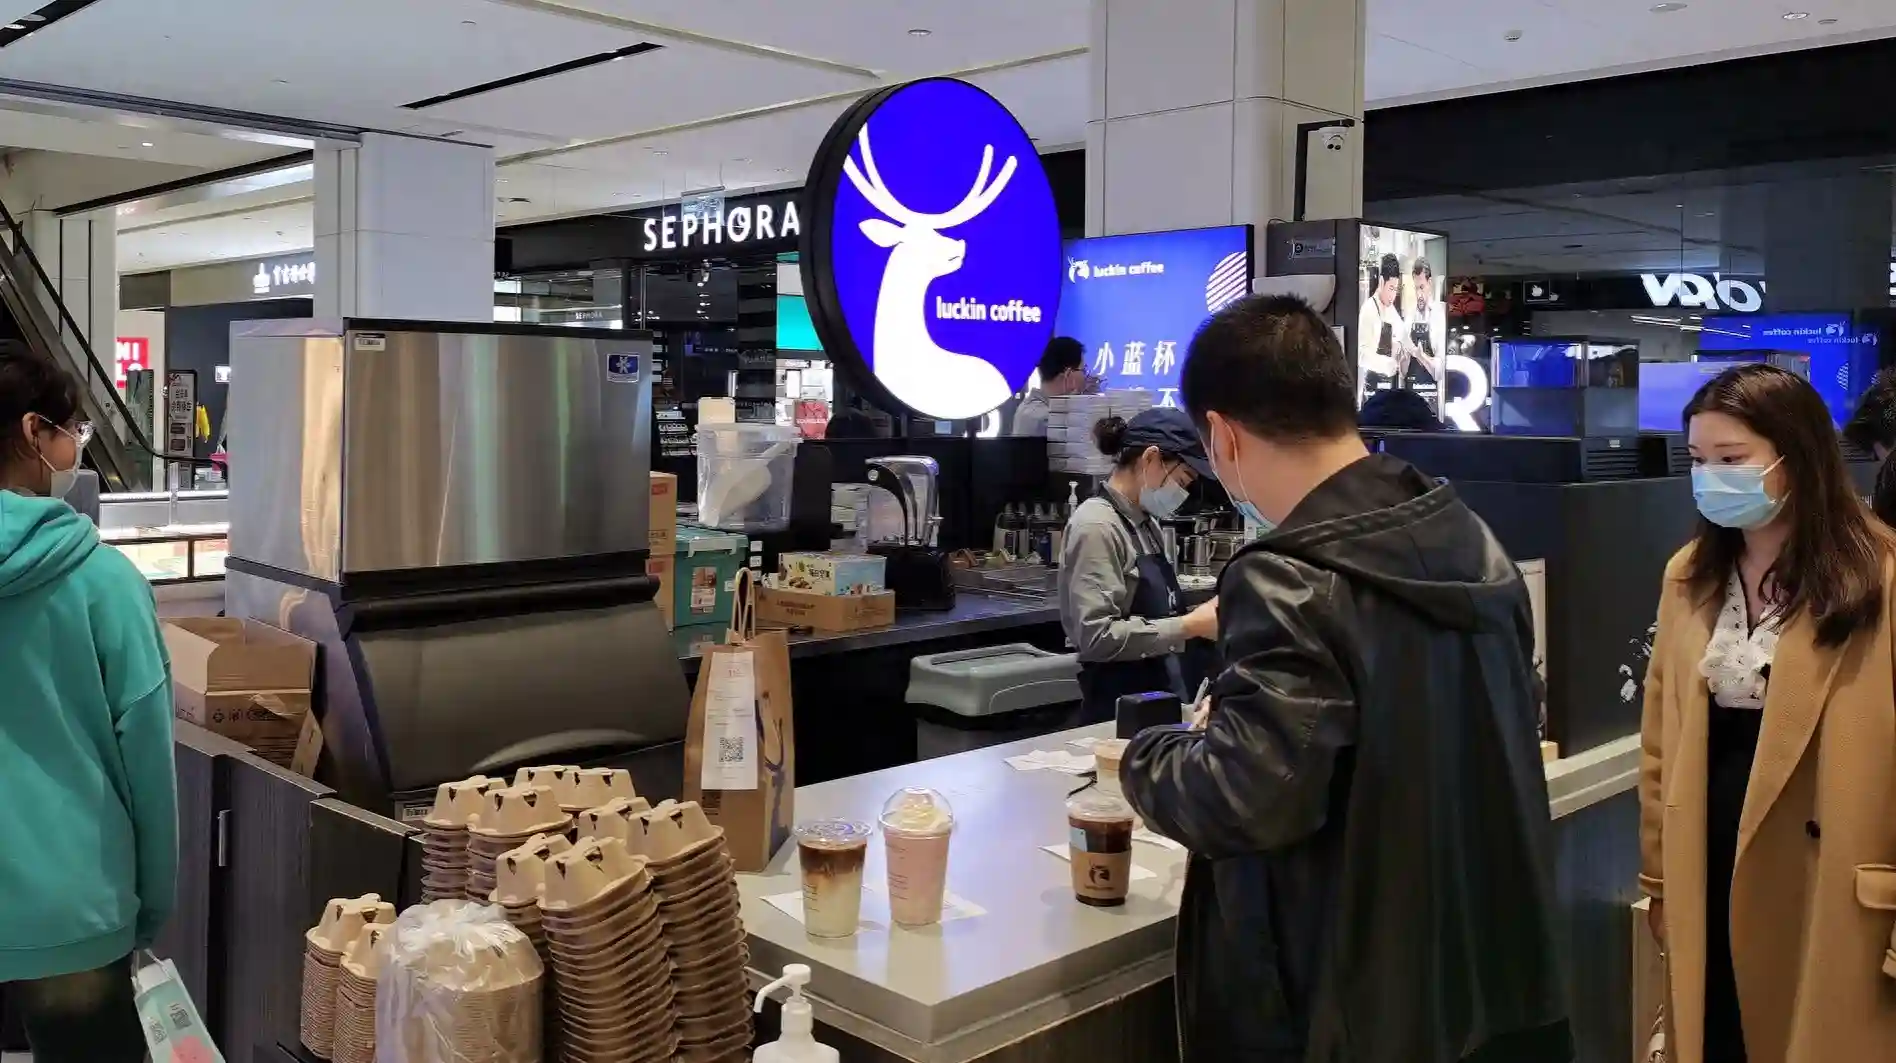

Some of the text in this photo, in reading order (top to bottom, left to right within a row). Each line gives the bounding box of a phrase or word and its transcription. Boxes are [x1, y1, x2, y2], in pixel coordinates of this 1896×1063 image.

[643, 200, 801, 252] SEPHORA
[1093, 261, 1165, 278] luckin coffee
[935, 295, 1042, 323] luckin coffee
[1092, 340, 1177, 375] 小蓝杯
